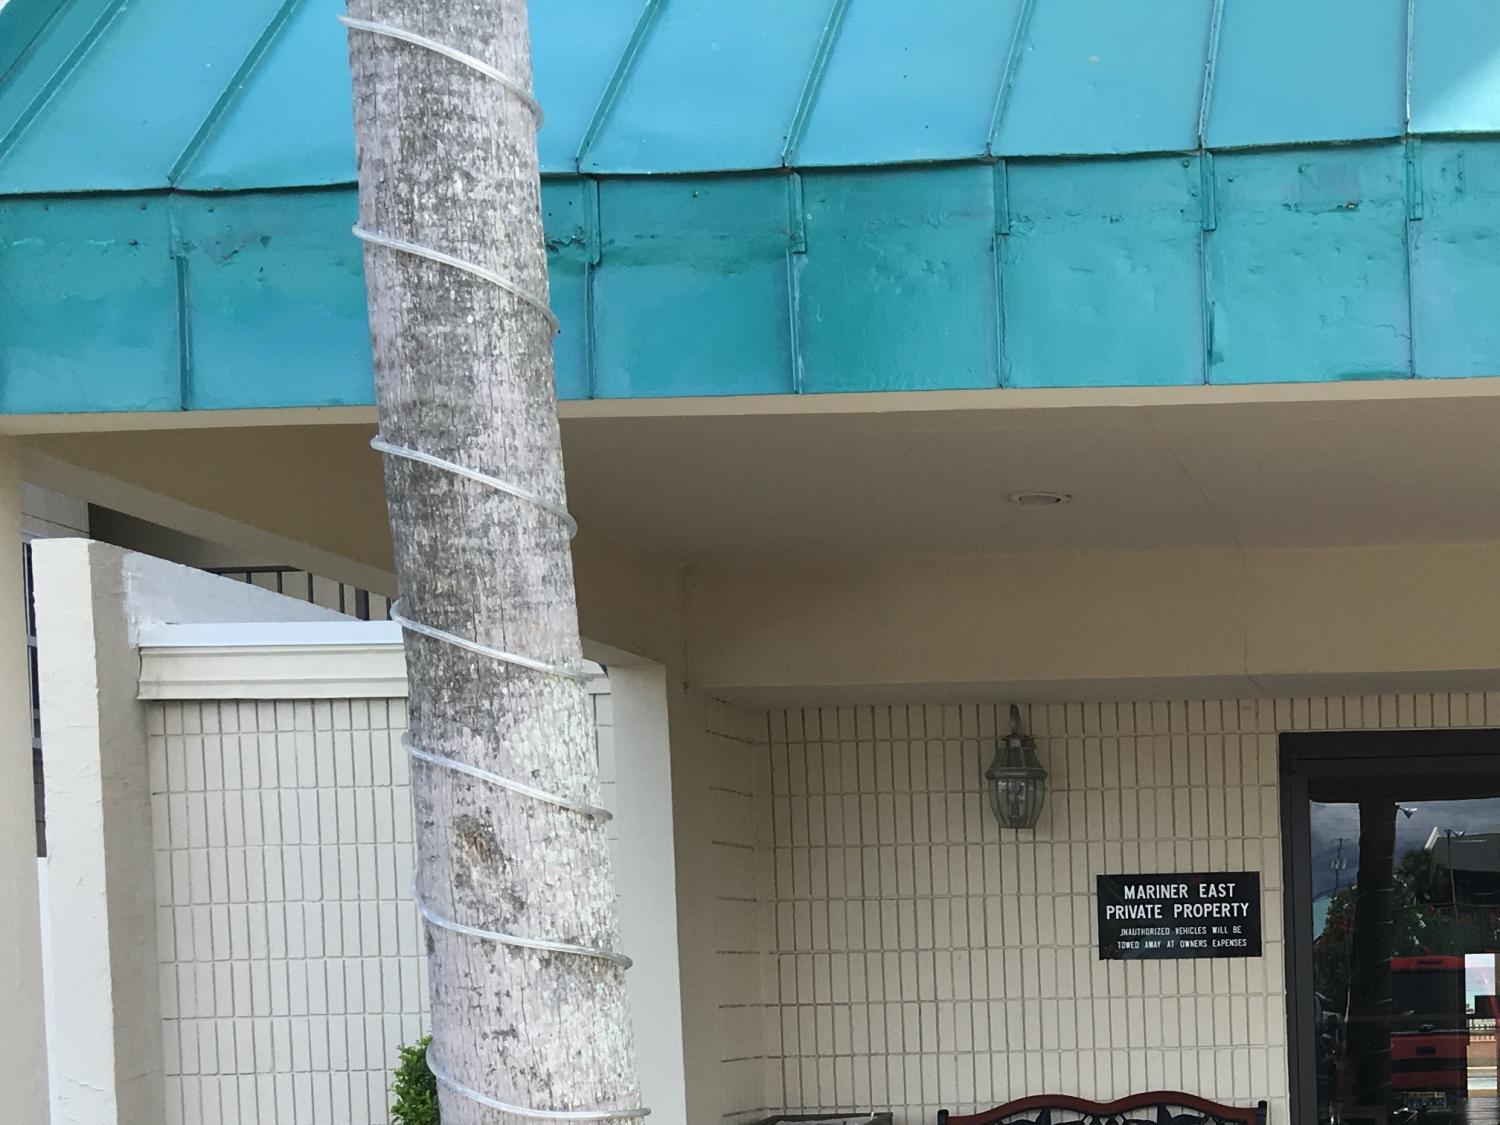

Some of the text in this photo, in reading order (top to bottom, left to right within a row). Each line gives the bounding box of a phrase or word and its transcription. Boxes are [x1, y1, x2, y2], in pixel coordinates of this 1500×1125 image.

[1124, 883, 1235, 899] MARINER EAST
[1106, 902, 1249, 920] PRIVATE PROPERTY
[1120, 925, 1242, 936] UNAUTHORIZED VEHICLES WILL BE
[1117, 941, 1139, 949] TOWED
[1145, 941, 1161, 949] AWAY
[1167, 940, 1174, 948] AT
[1180, 940, 1207, 948] OWNERS
